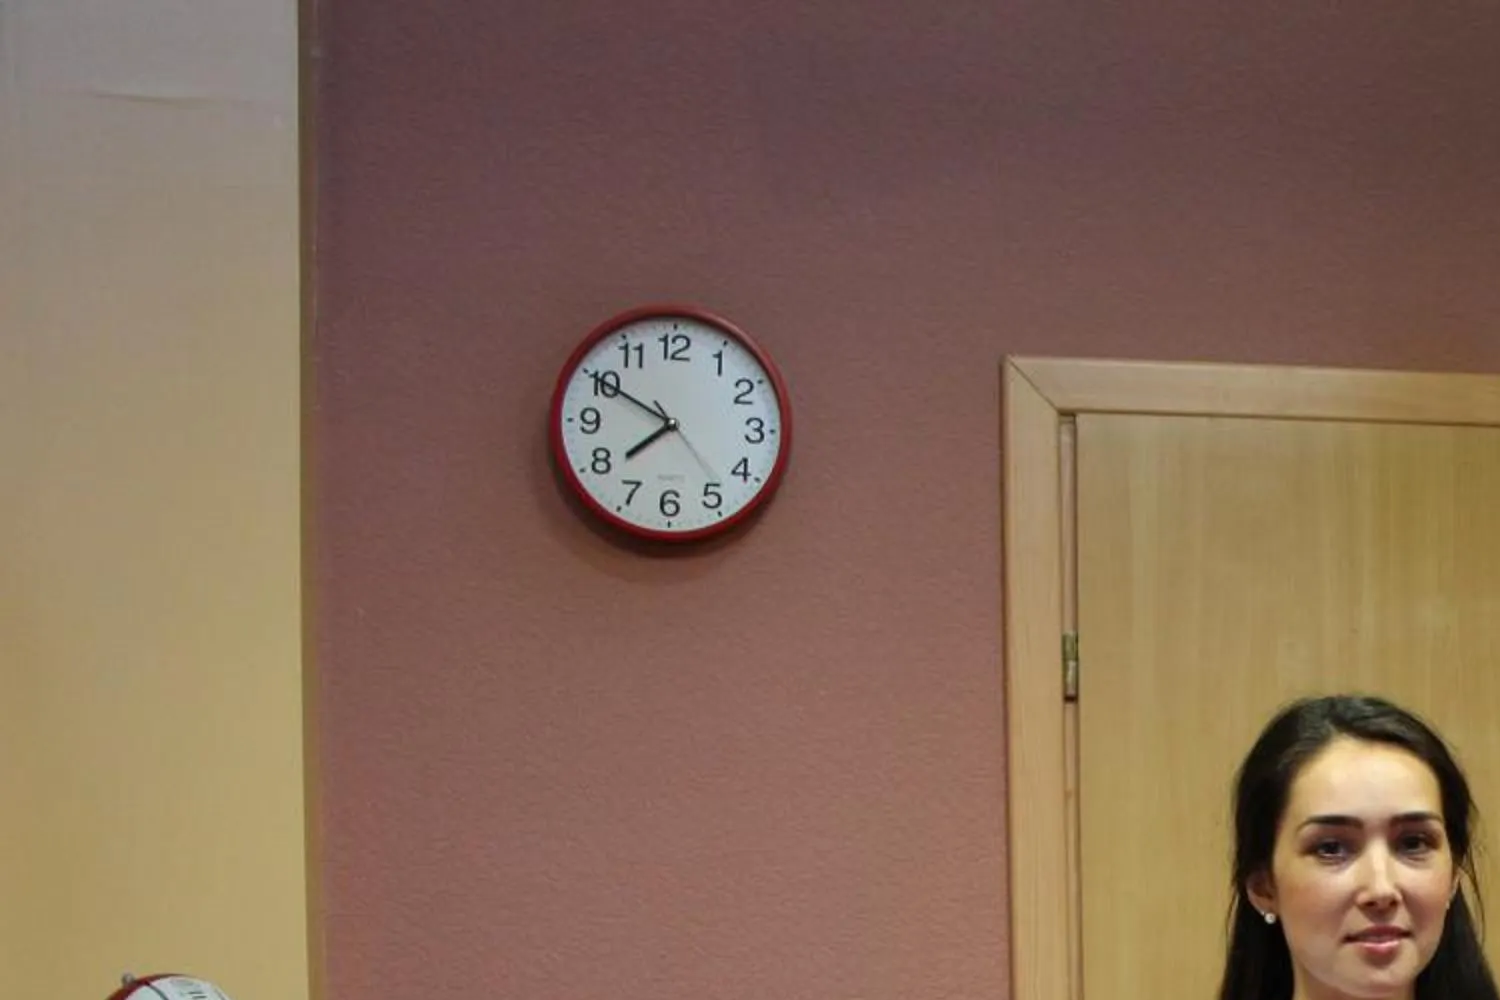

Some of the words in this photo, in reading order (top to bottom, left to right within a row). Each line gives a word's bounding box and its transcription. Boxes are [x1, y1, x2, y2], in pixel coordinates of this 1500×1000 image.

[618, 342, 644, 369] 11
[658, 333, 691, 362] 12
[712, 350, 724, 377] 1
[588, 371, 621, 398] 10
[733, 378, 754, 405] 2
[580, 407, 601, 434] 9
[744, 418, 765, 444] 3
[591, 448, 611, 475] 8
[731, 457, 751, 483] 4
[621, 480, 643, 506] 7
[659, 490, 681, 517] 6
[702, 483, 722, 509] 5
